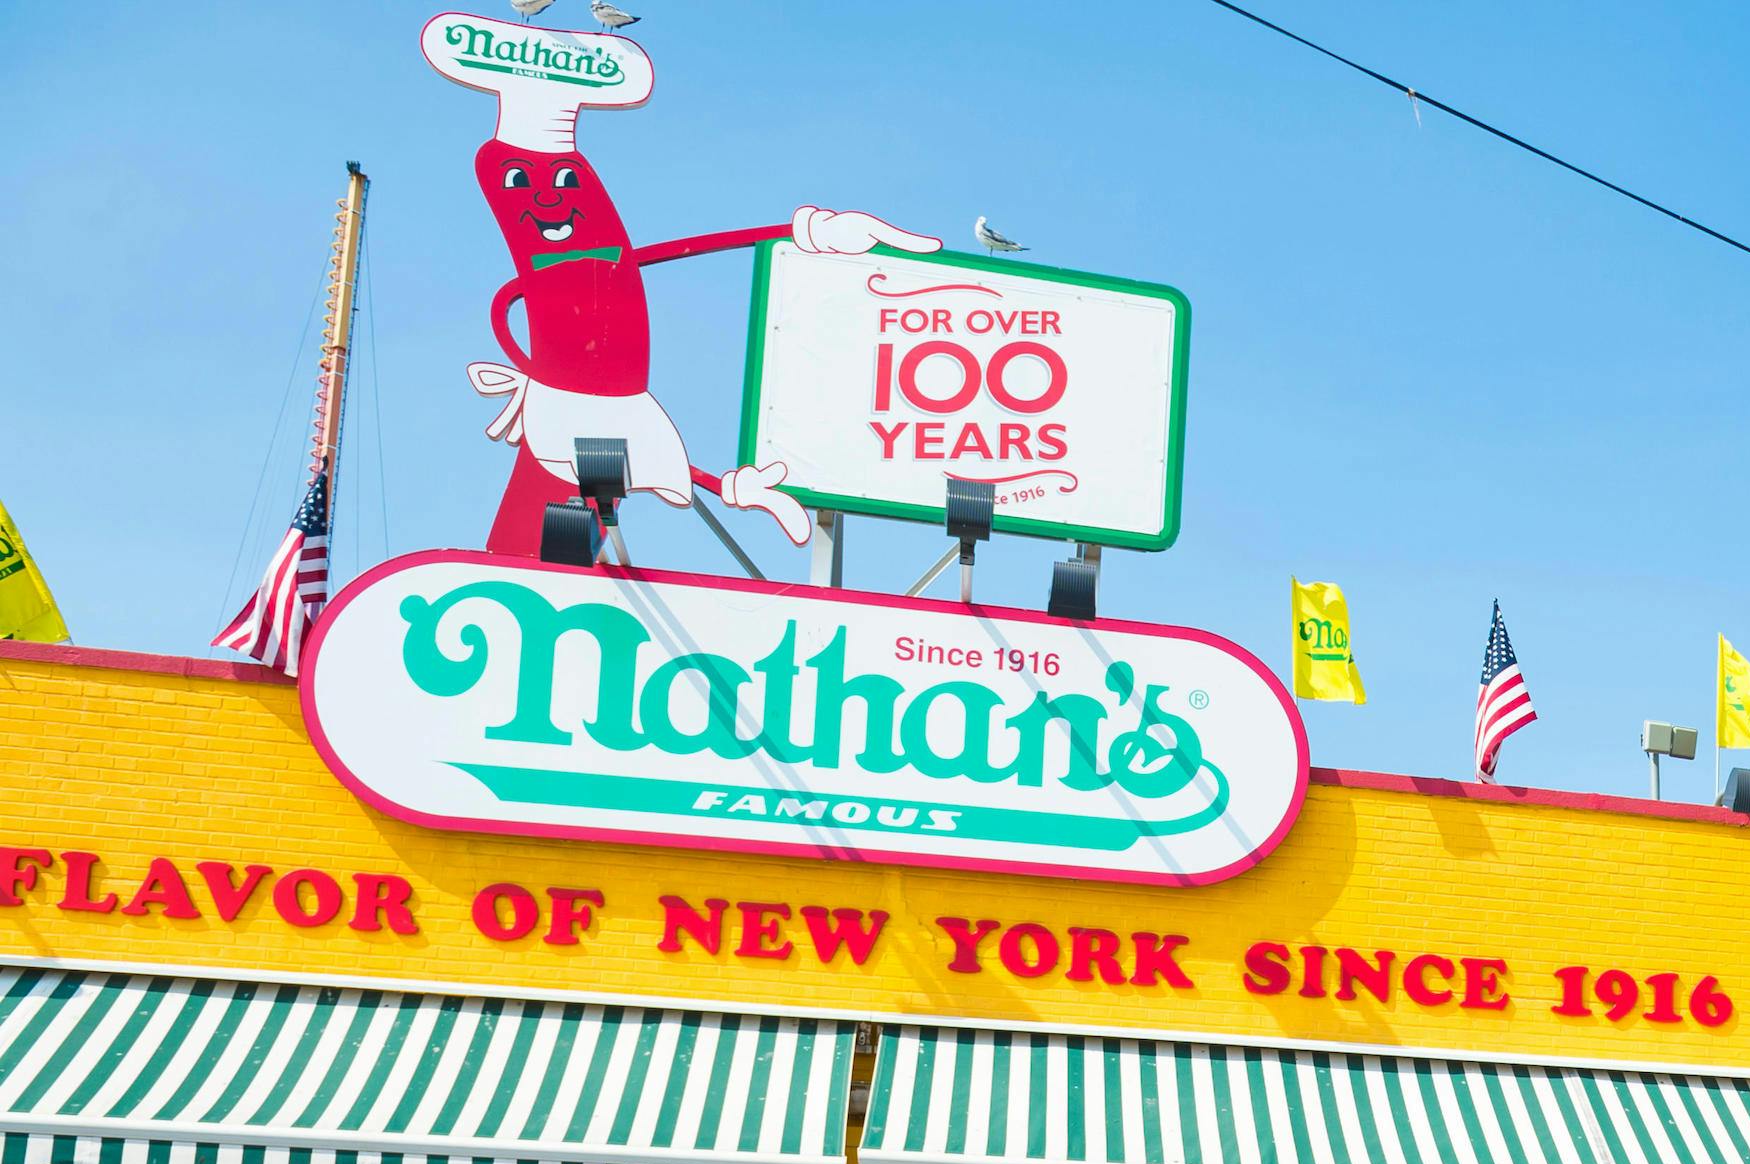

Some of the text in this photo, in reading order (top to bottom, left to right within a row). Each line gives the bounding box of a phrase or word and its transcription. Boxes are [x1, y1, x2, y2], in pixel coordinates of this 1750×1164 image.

[446, 24, 619, 78] Nathan's
[880, 309, 1062, 334] FOR OVER
[874, 341, 1069, 414] 100
[870, 421, 1069, 461] YEARS
[895, 636, 1061, 678] Since 1916
[399, 580, 1203, 799] Nathan's
[692, 789, 964, 833] FAMOUS
[0, 847, 1733, 1027] FLAVOR OF NEW YORK SINCE 1916
